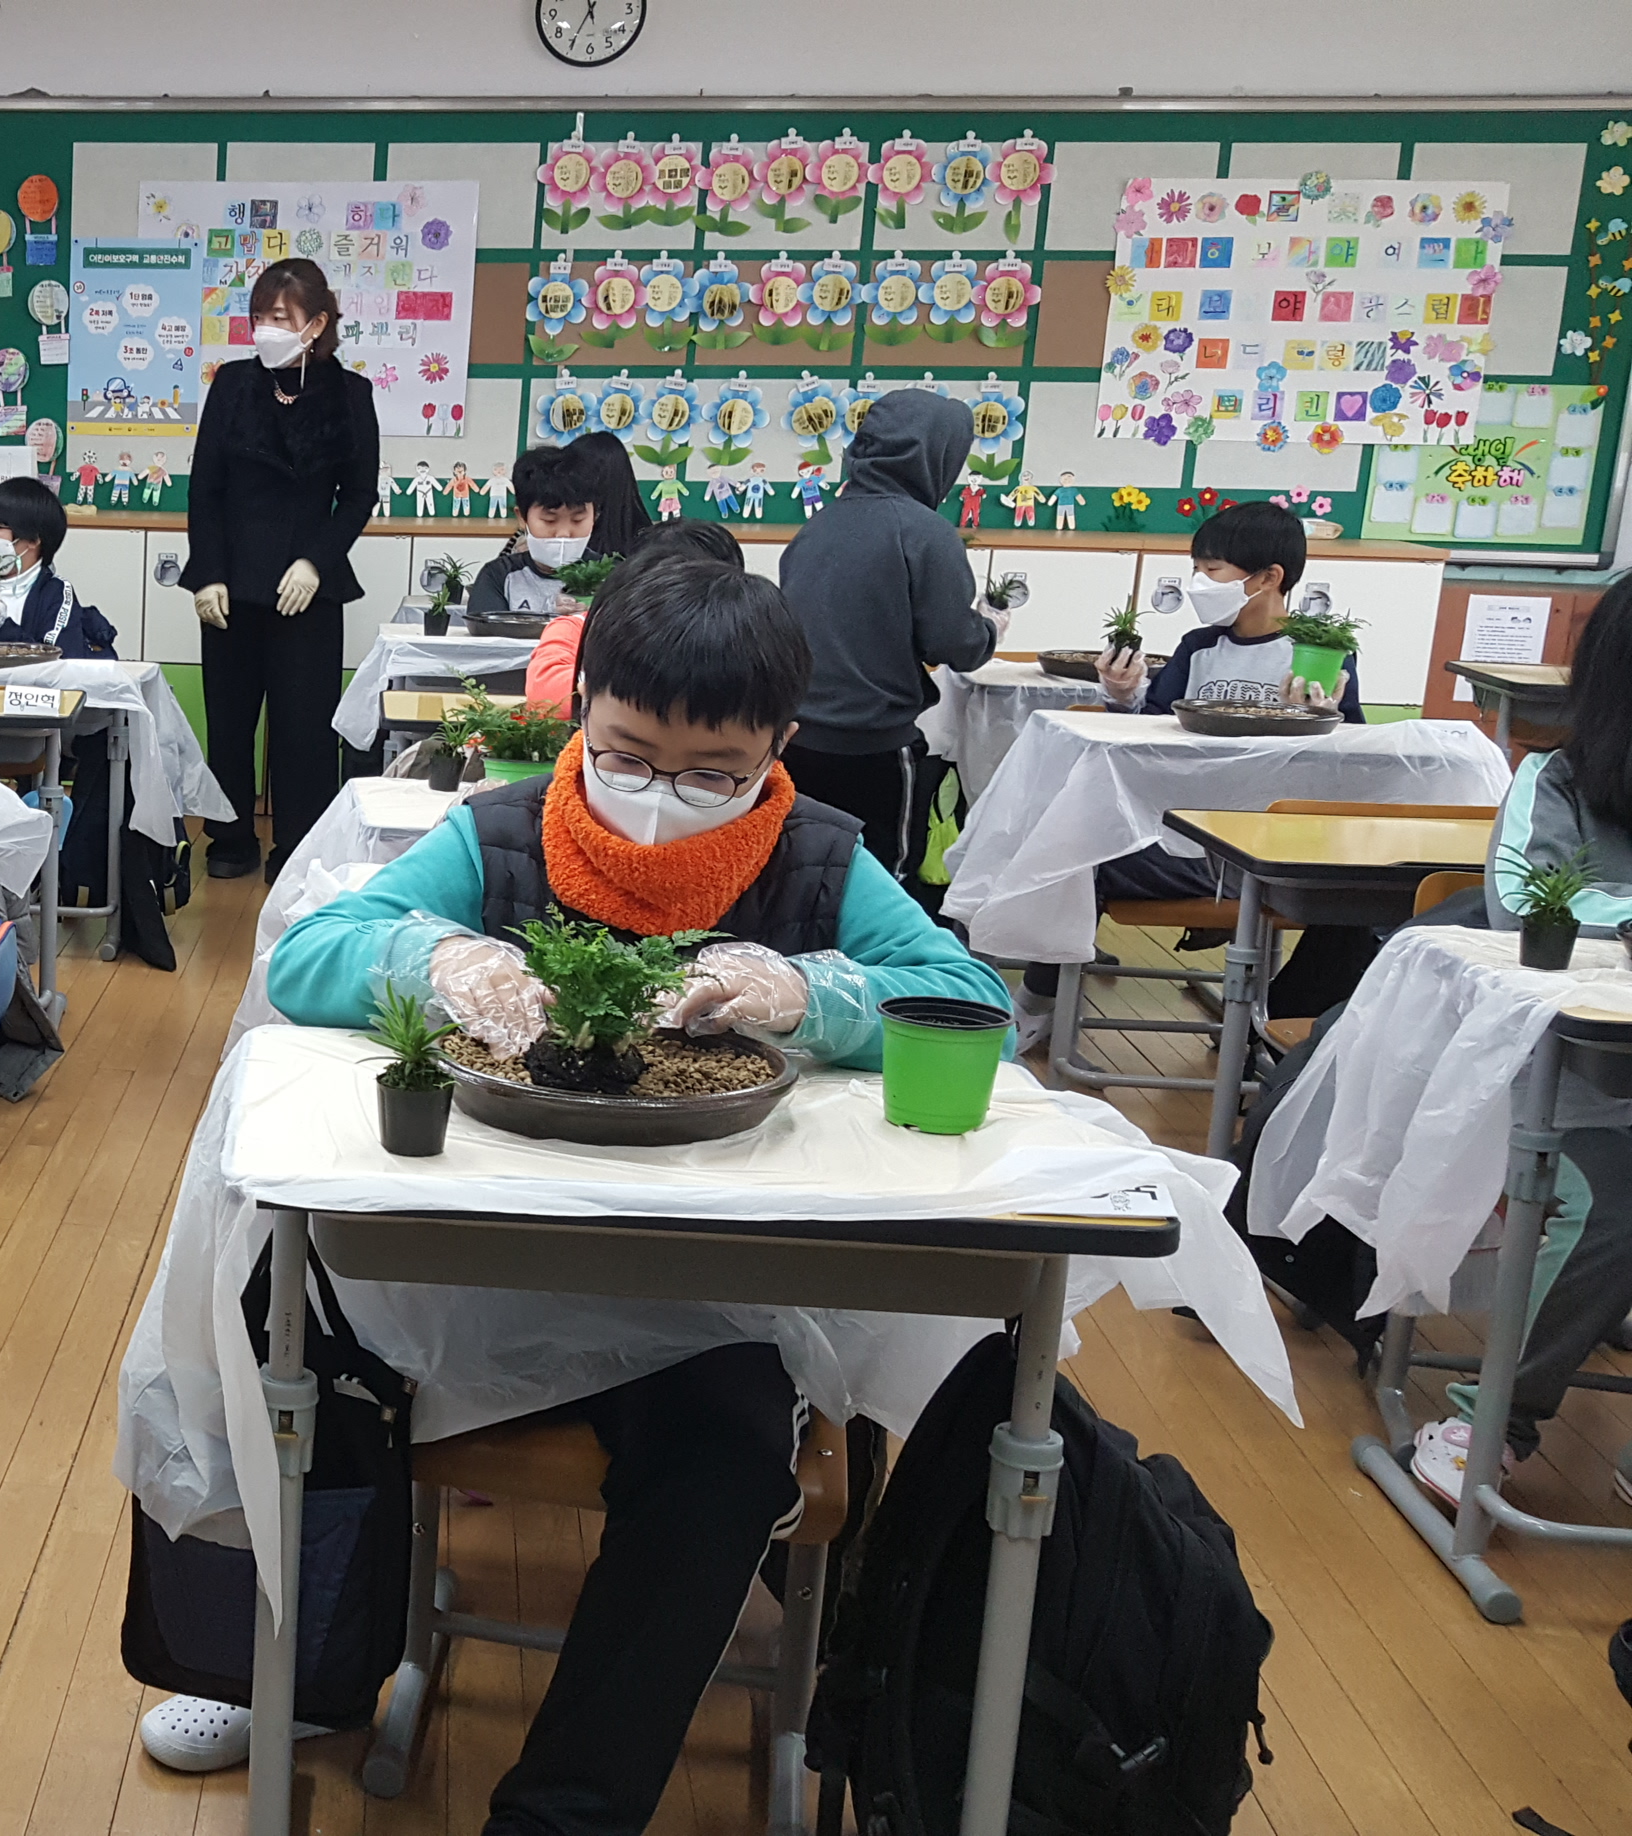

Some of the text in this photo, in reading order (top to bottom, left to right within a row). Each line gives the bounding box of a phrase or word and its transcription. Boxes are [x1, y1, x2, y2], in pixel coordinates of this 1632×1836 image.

[548, 8, 558, 20] 9
[554, 27, 563, 39] 8
[604, 36, 614, 49] 5
[585, 43, 595, 55] 6
[332, 232, 410, 258] 즐거워
[1447, 461, 1526, 491] 축하해
